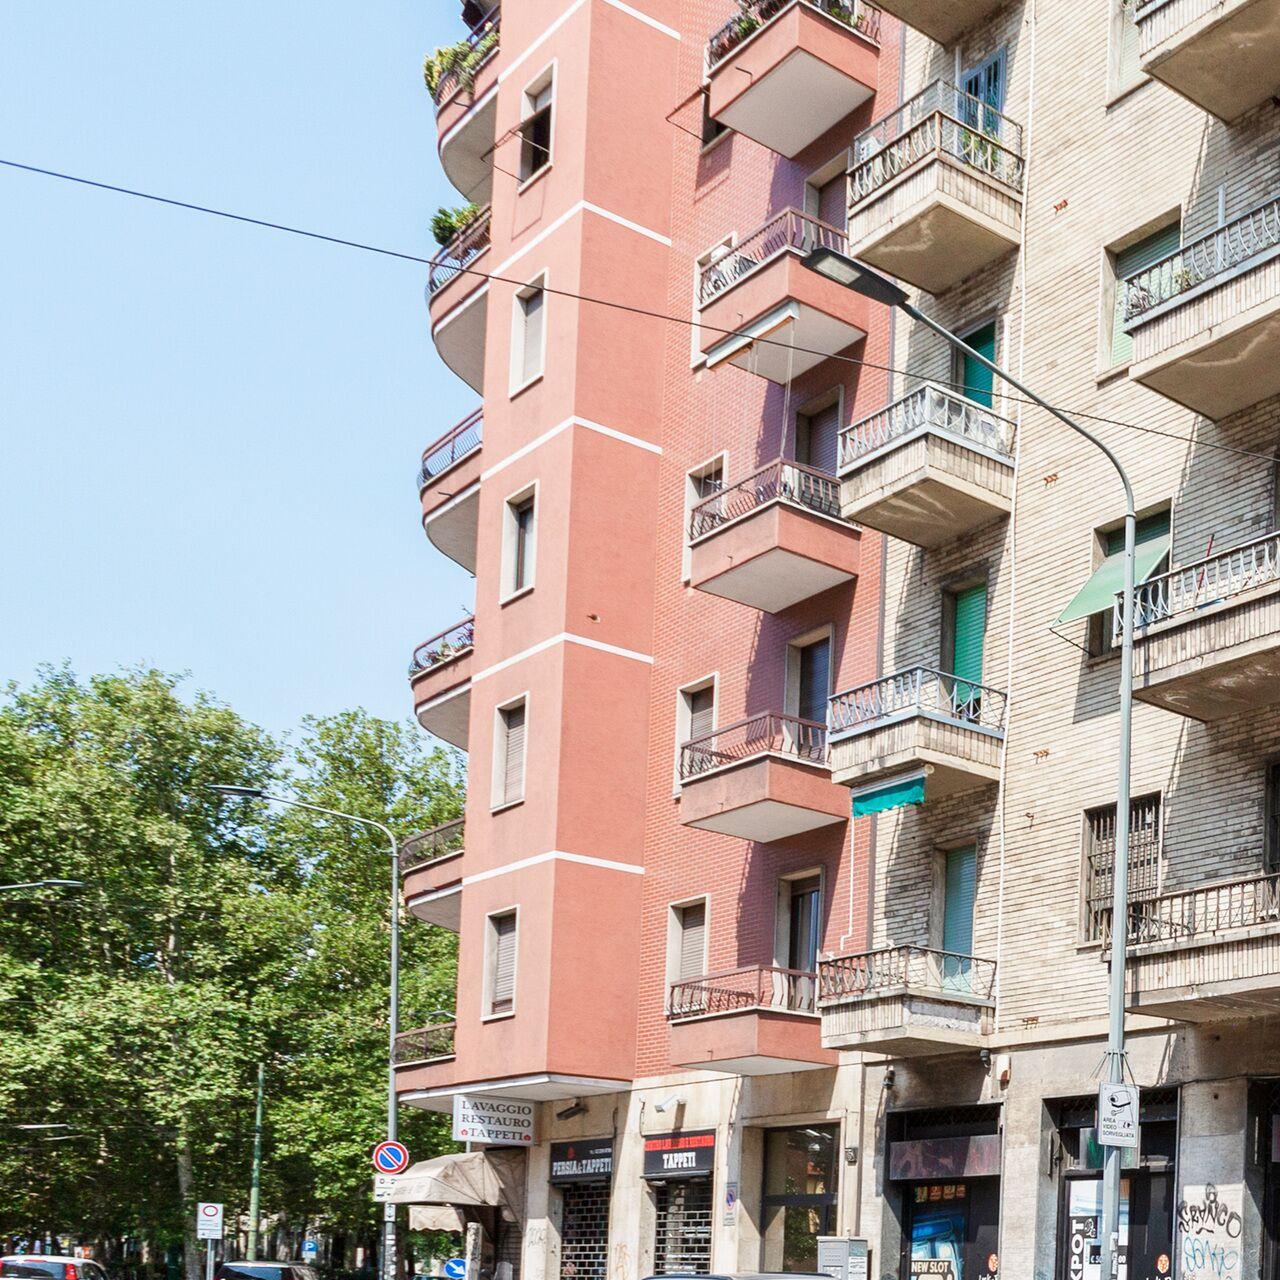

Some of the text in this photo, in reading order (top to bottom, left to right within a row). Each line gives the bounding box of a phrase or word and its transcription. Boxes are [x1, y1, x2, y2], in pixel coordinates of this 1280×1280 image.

[462, 1100, 532, 1116] LAVAGGIO
[462, 1114, 532, 1128] RESTAURO
[469, 1127, 524, 1142] TAPPETI
[662, 1151, 696, 1169] TAPPETI
[911, 1261, 949, 1274] NEW SLOT
